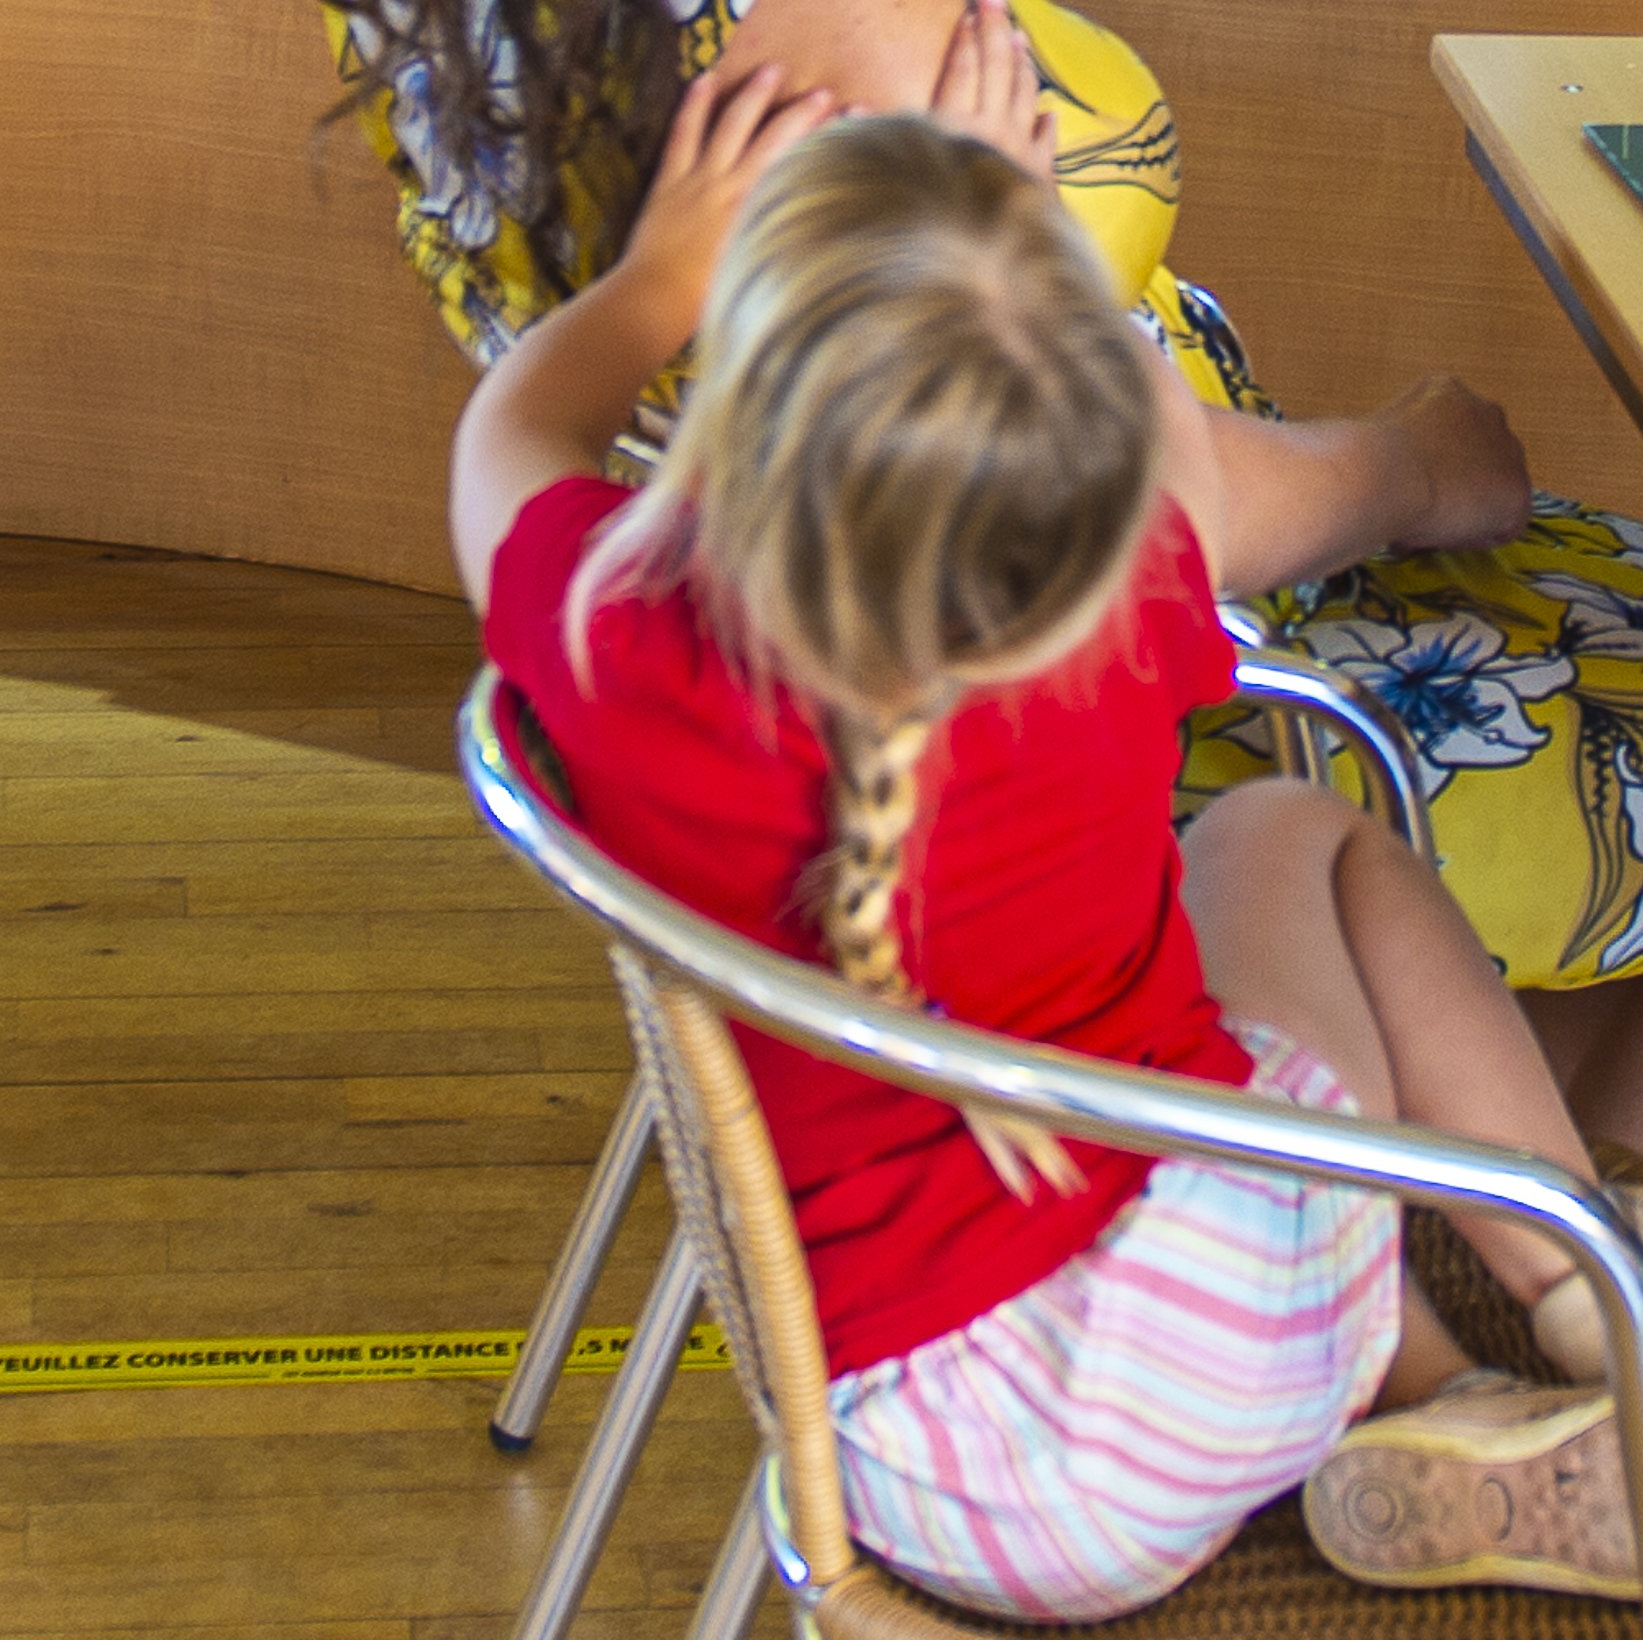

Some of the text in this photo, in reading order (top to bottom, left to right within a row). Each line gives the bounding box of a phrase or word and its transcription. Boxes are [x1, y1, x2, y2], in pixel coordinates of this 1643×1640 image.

[0, 1353, 120, 1372] EUILLEZ
[127, 1349, 297, 1368] CONSERVER
[304, 1346, 362, 1362] UNE
[369, 1341, 509, 1359] DISTANCE
